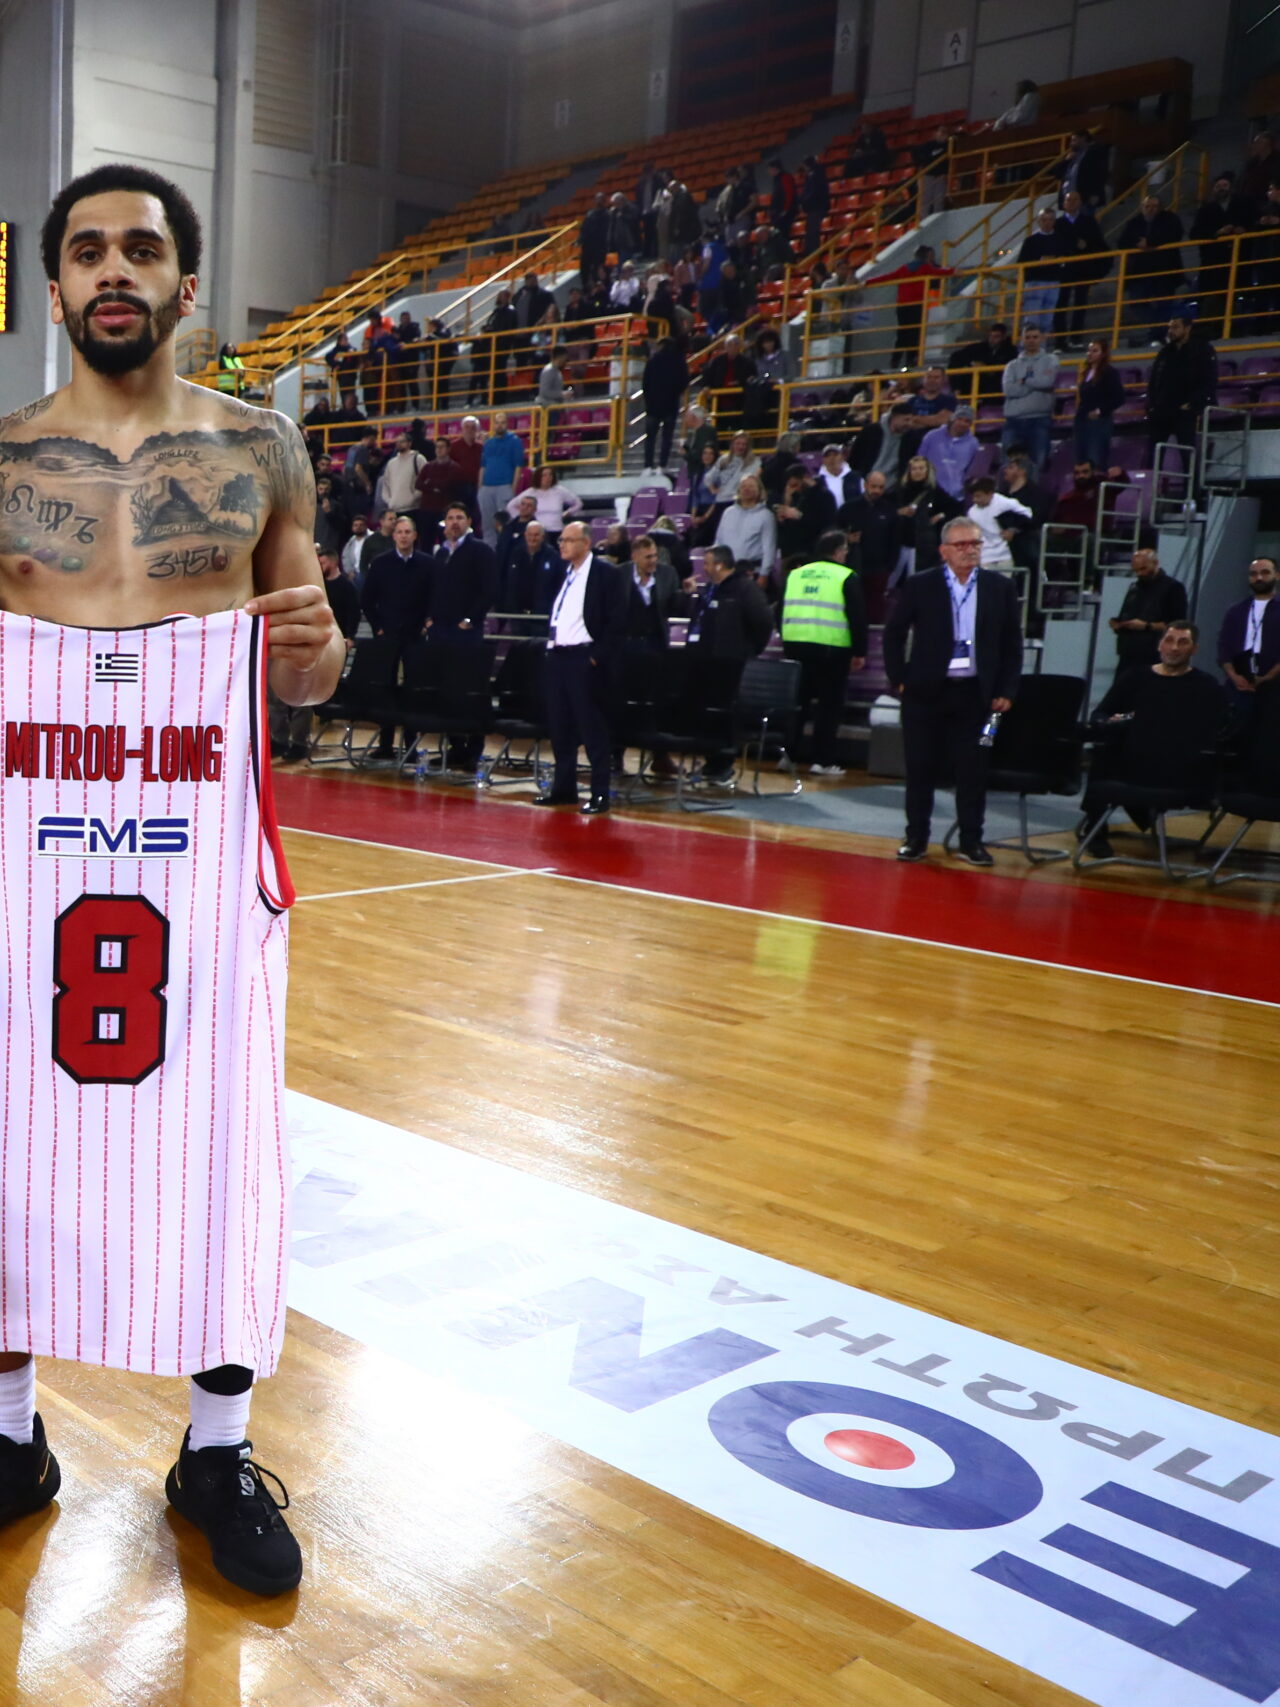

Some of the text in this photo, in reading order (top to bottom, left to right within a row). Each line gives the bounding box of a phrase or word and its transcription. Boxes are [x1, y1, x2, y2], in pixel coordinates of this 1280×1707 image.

[5, 721, 223, 783] MITROU-LONG
[37, 816, 190, 854] FMS
[52, 893, 170, 1085] 8
[794, 1316, 1276, 1503] ΠΡΩΤΗ
